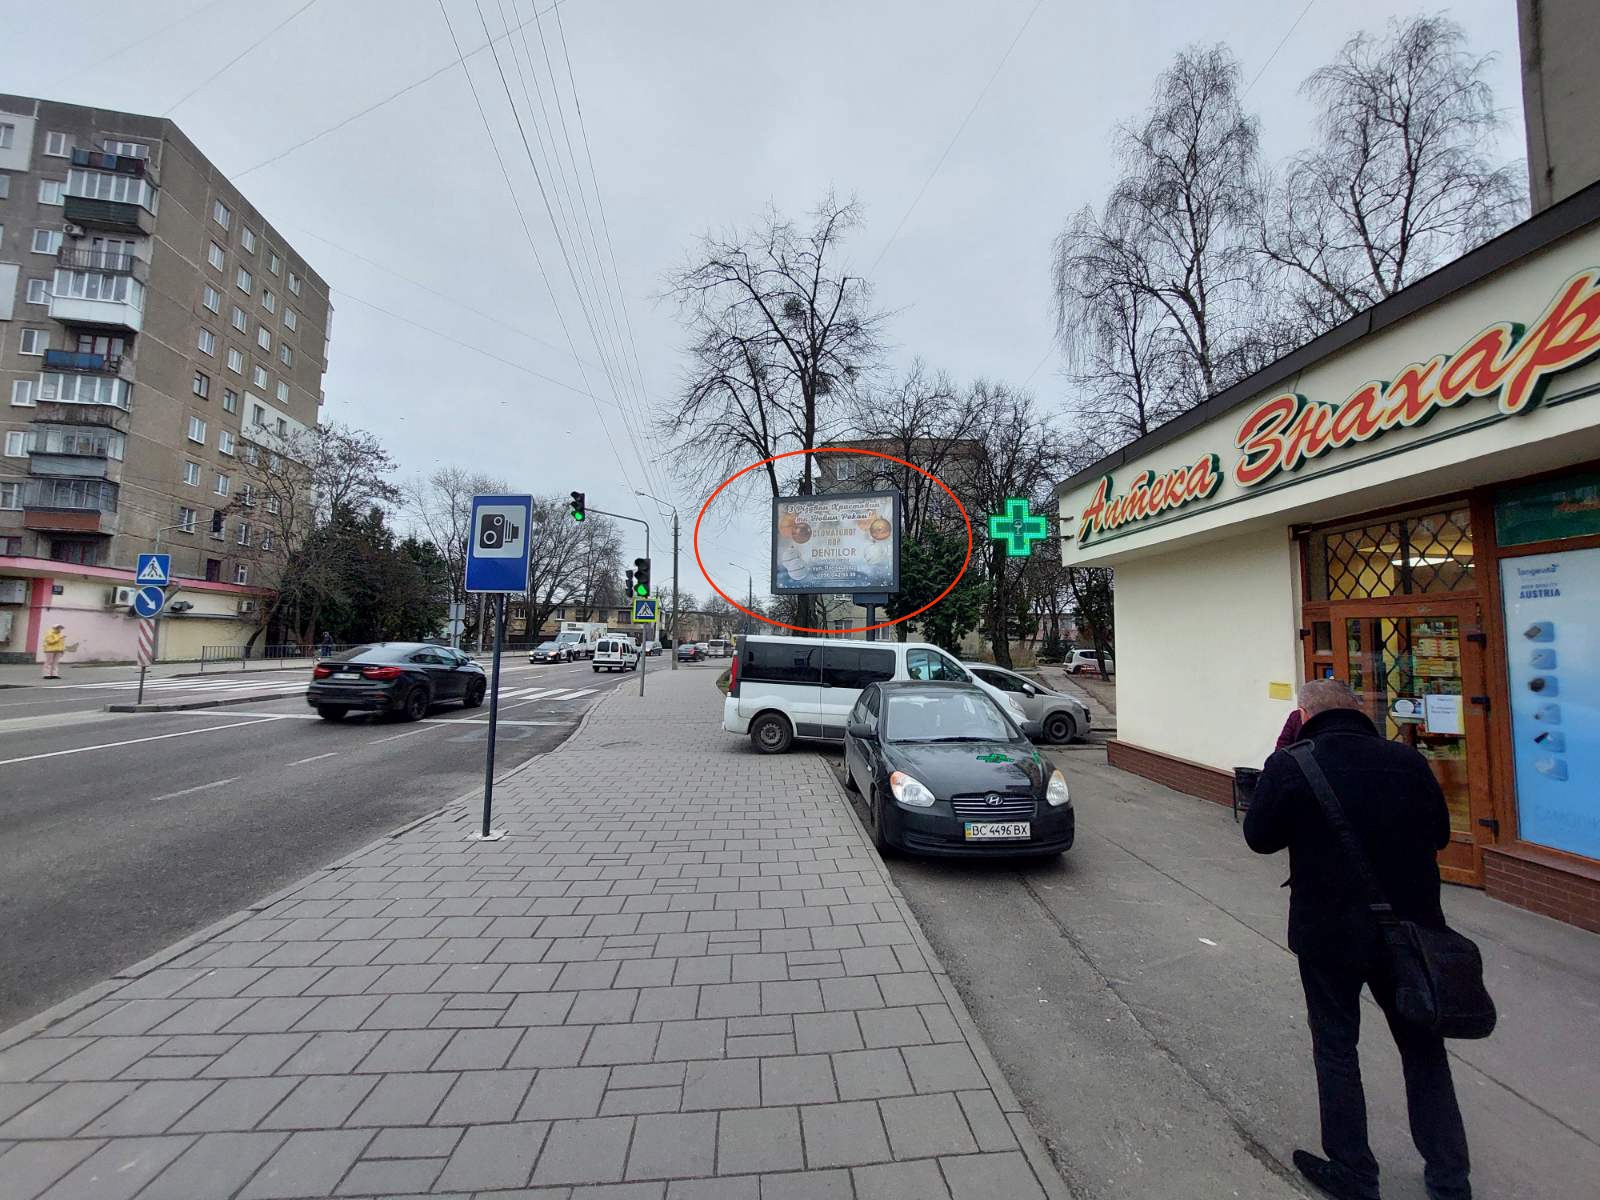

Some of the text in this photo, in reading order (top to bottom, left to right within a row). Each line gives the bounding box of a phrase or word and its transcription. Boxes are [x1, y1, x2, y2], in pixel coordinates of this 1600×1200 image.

[1079, 267, 1600, 541] Аптека Знахар
[811, 548, 857, 557] DENTILOR
[1520, 589, 1560, 599] AUSTRIA
[972, 825, 986, 836] BC
[989, 825, 1012, 835] 4496
[1013, 825, 1027, 835] BX
